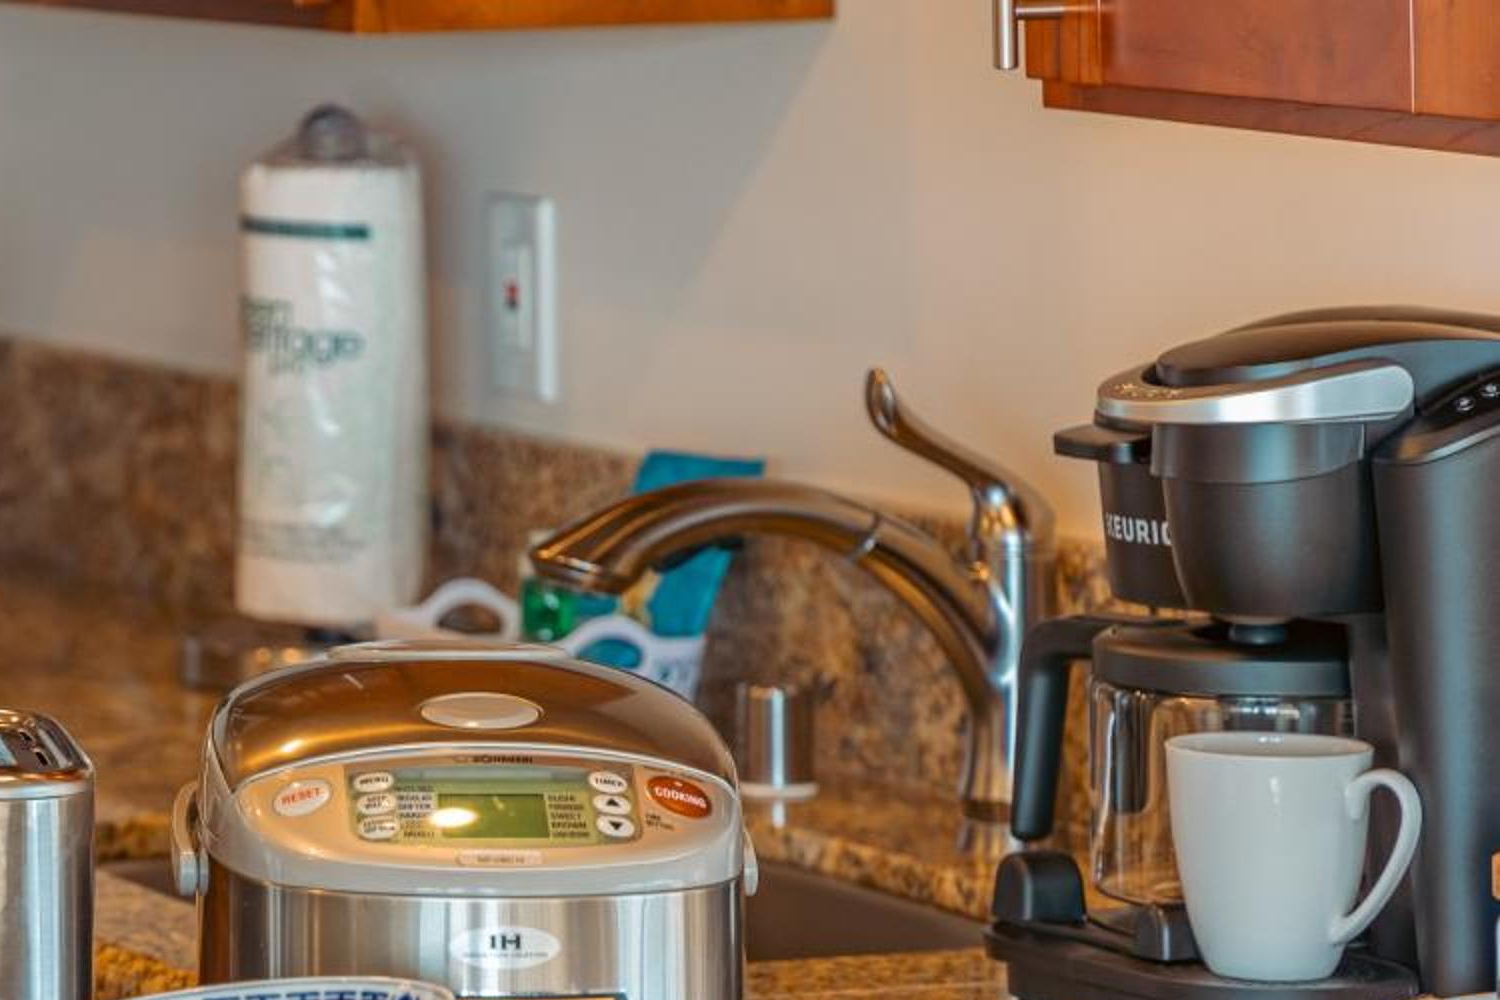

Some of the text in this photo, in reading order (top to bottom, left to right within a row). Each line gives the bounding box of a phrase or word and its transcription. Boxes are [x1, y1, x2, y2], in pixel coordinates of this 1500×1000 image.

[281, 787, 321, 805] RESET
[654, 787, 708, 809] COOKING
[490, 934, 521, 950] IH
